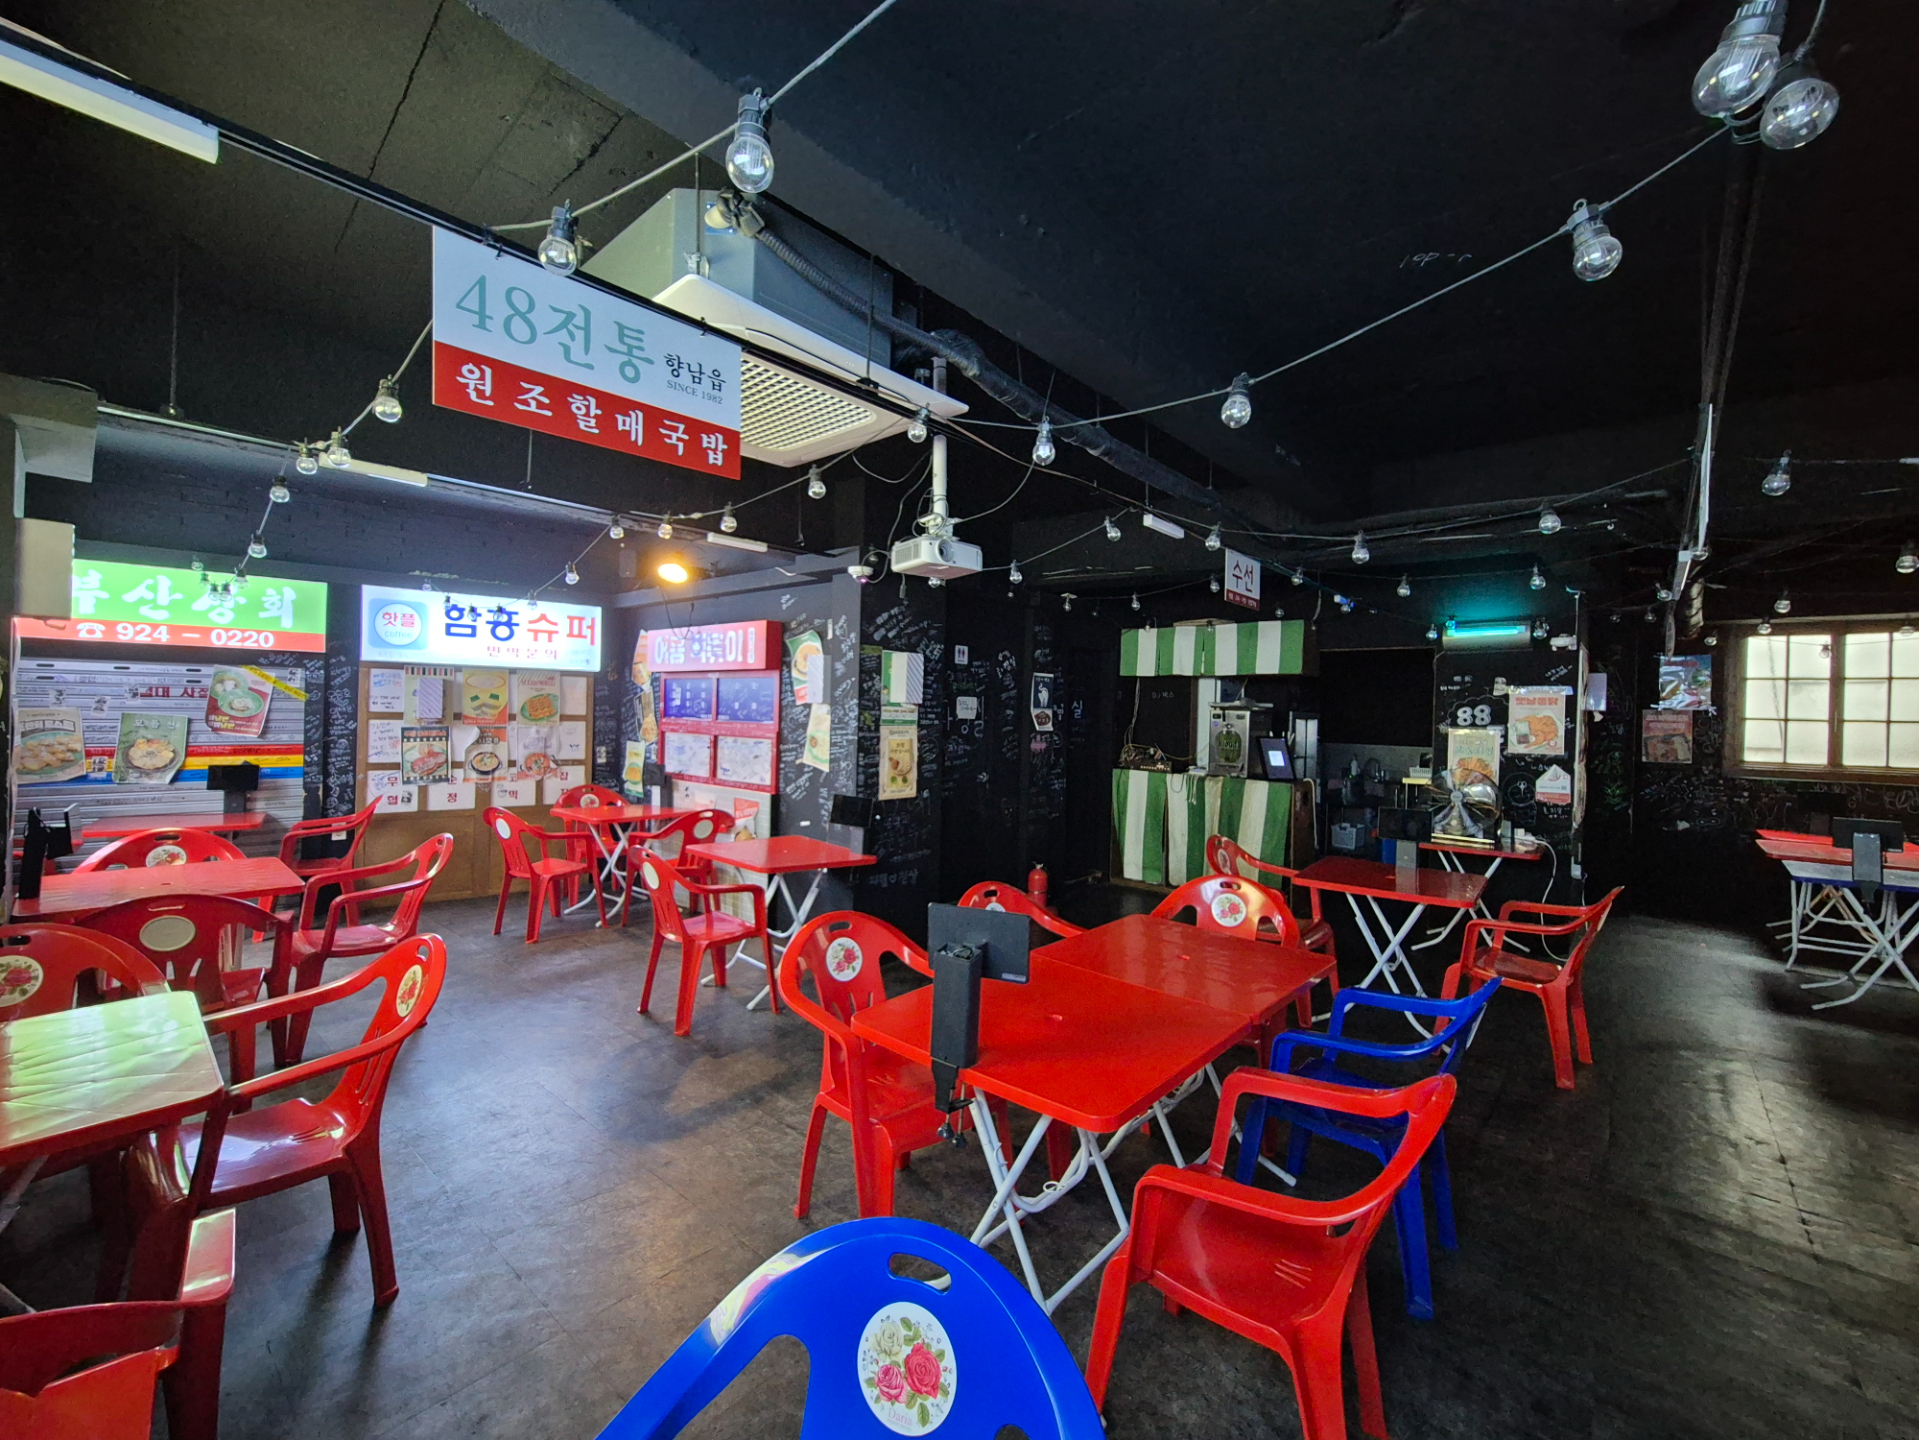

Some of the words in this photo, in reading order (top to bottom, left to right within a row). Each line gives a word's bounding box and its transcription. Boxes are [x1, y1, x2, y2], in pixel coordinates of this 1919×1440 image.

[455, 273, 655, 385] 48전통
[663, 352, 727, 393] 향남읍
[666, 379, 699, 398] SINCE
[701, 387, 724, 405] 1982
[1232, 559, 1254, 593] 수선
[381, 611, 417, 628] 핫플
[115, 622, 170, 643] 924
[210, 629, 275, 648] 0220
[384, 629, 413, 639] coffee
[1457, 704, 1492, 726] 88
[887, 1406, 913, 1427] Daria
